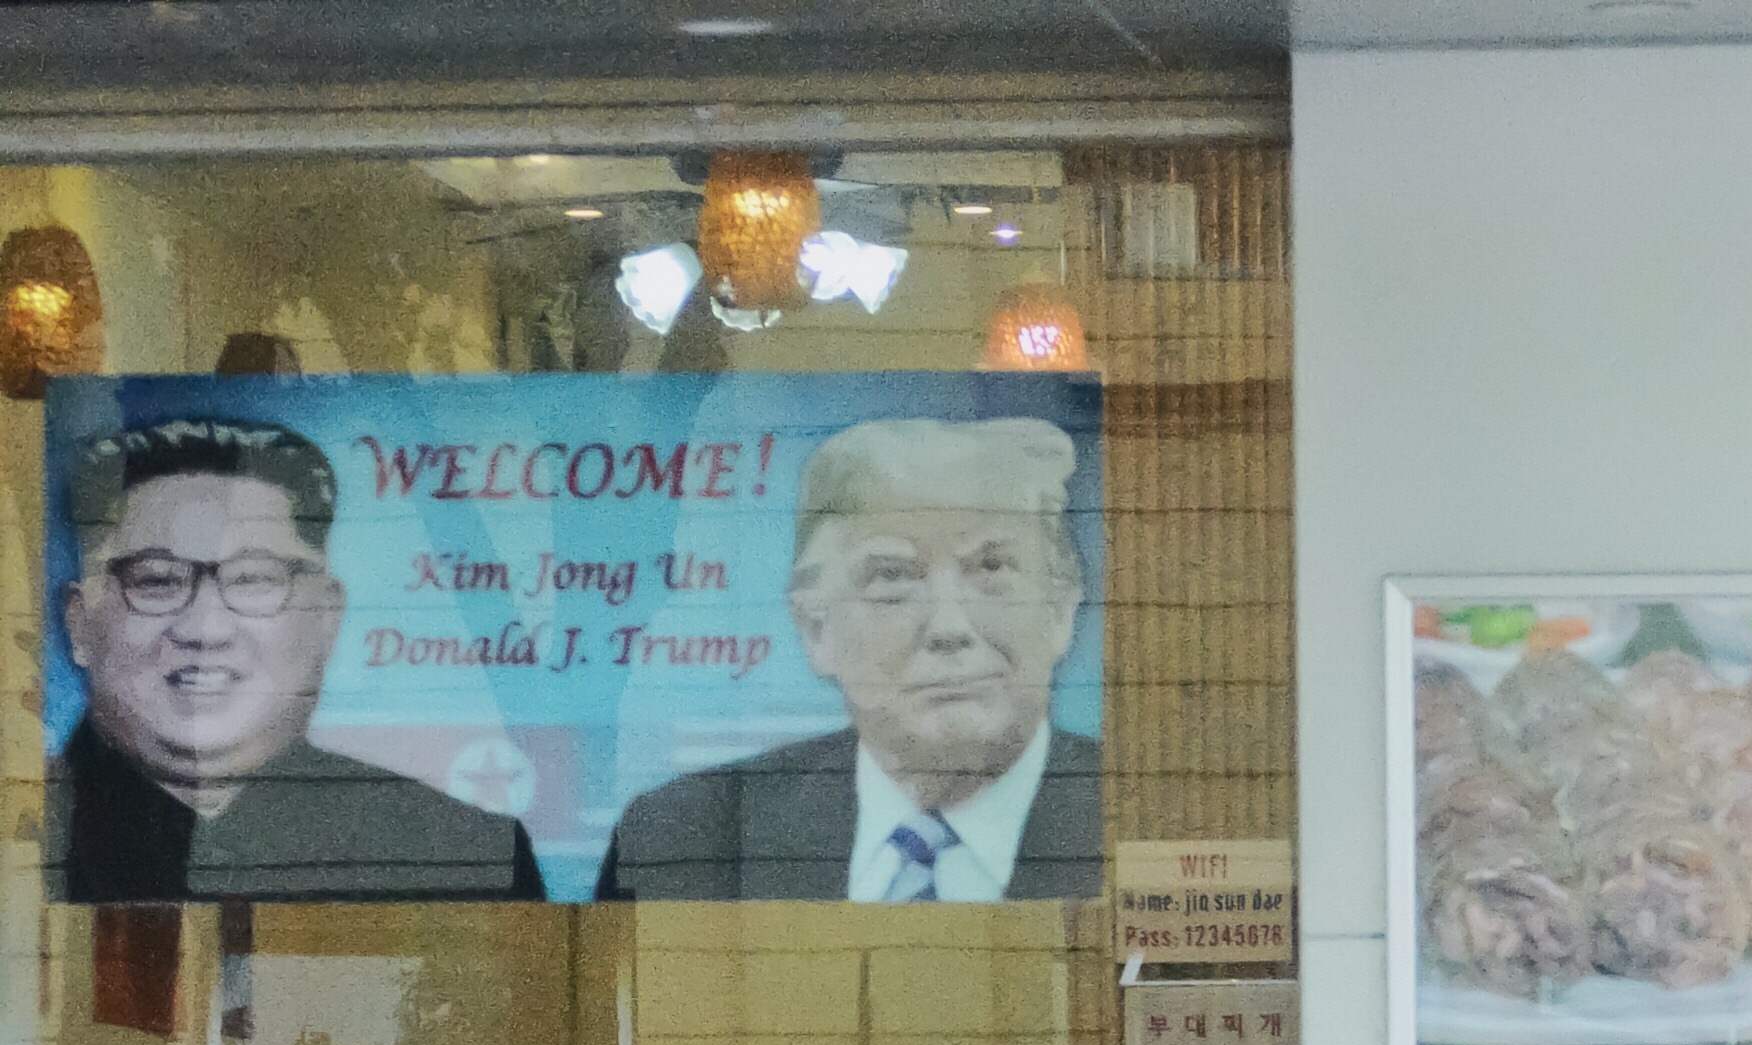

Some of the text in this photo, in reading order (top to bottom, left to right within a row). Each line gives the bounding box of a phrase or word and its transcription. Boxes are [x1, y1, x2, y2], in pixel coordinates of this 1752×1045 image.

[352, 433, 775, 501] WELCOME!
[404, 551, 729, 607] Kim Jong Un
[363, 621, 772, 681] Donald J. Trump
